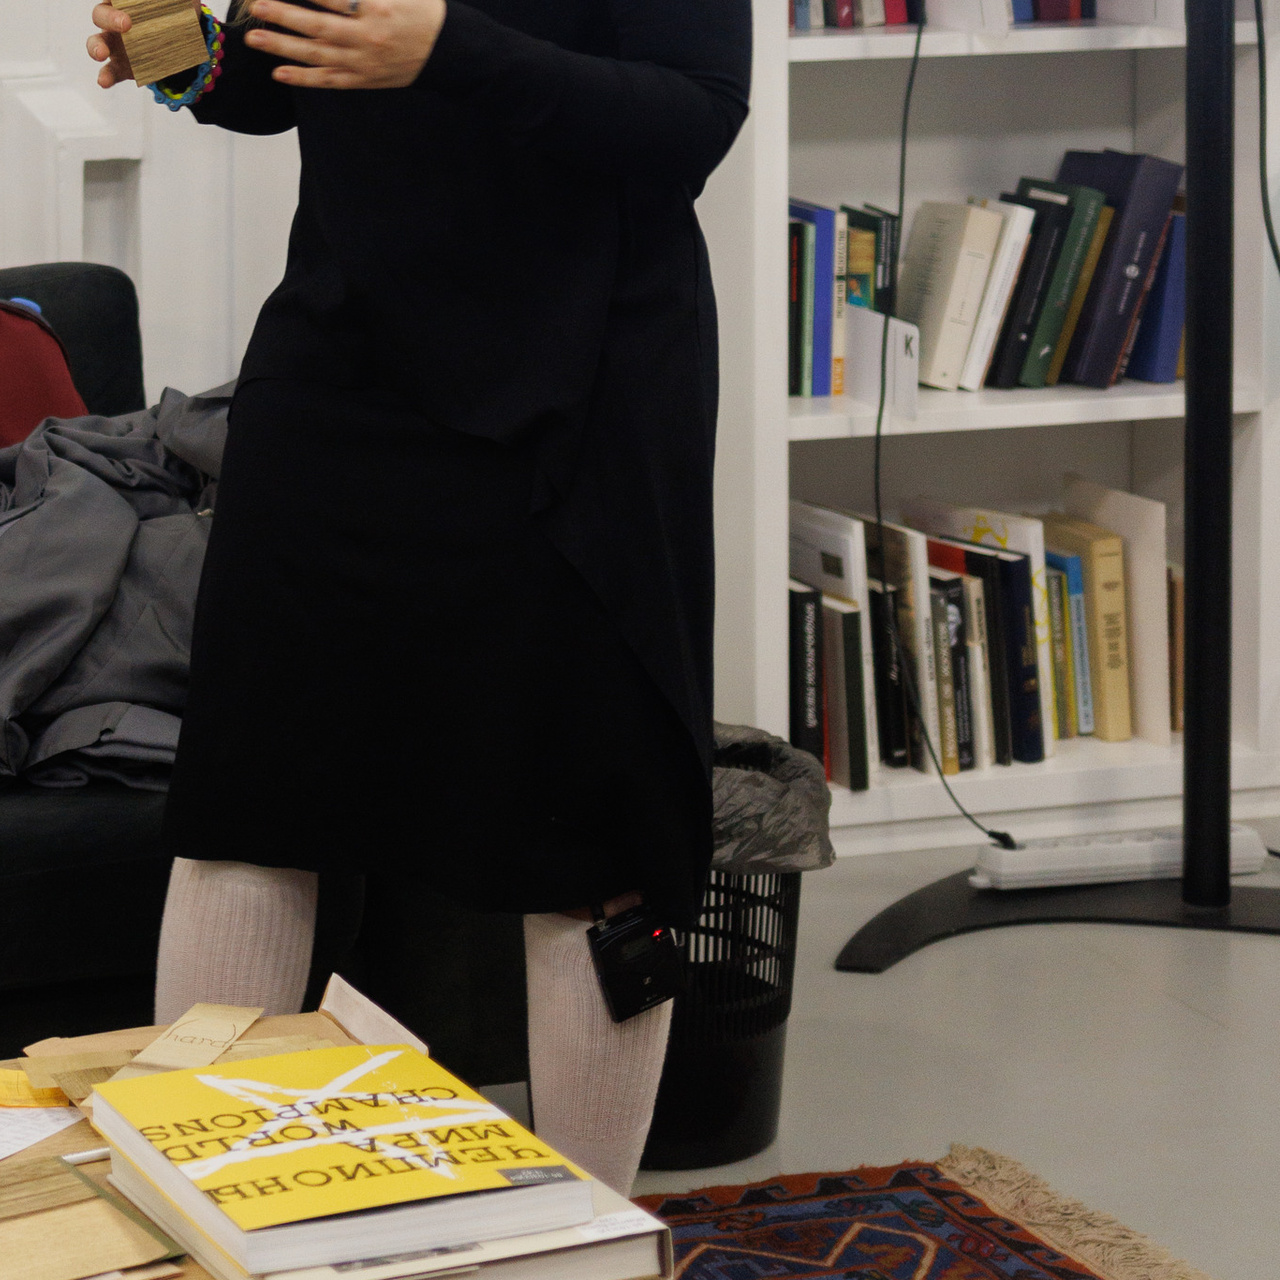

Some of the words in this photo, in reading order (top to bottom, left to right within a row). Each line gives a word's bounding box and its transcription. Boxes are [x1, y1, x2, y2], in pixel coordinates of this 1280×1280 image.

[140, 1086, 460, 1144] CHAMPIONS
[340, 1122, 515, 1154] МИРА
[163, 1119, 363, 1163] WORLD
[203, 1144, 551, 1205] ЧЕМПИОНЫ
